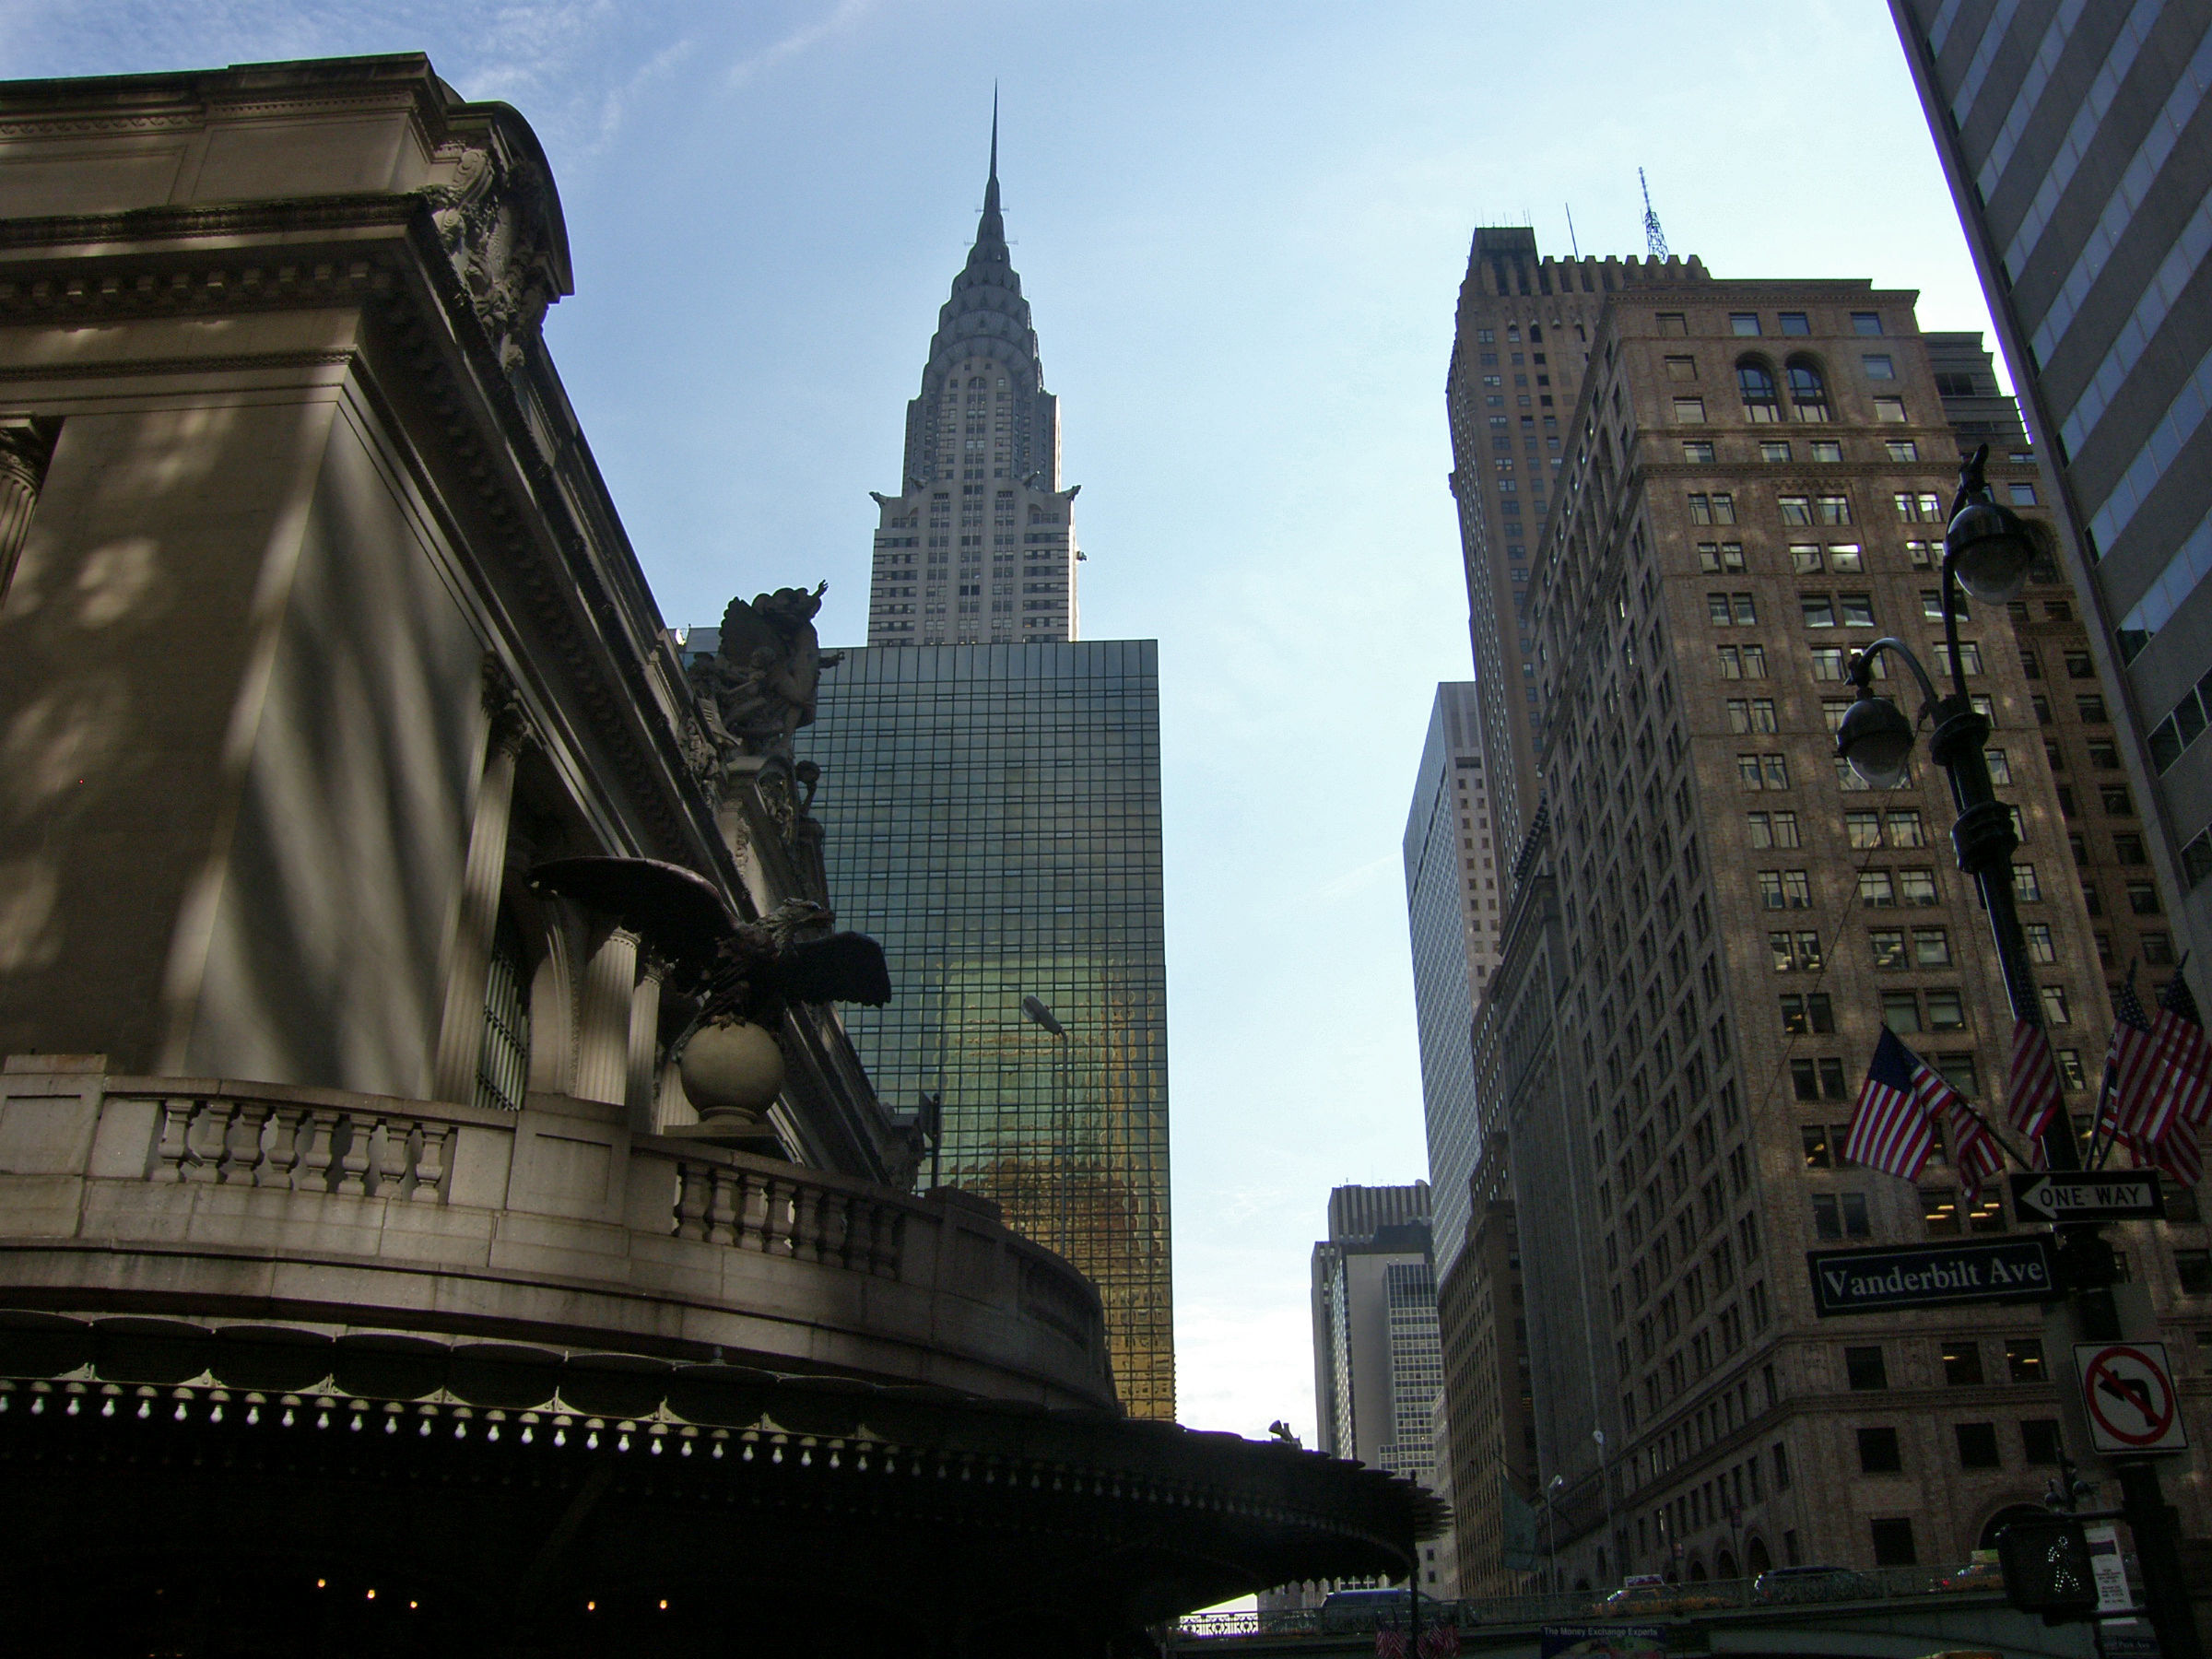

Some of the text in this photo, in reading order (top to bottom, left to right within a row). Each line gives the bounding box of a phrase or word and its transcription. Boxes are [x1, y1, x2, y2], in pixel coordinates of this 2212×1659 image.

[2040, 1186, 2138, 1206] ONE WAY
[1824, 1257, 2043, 1298] Vanderbilt Ave
[1544, 1627, 1658, 1638] The Money Exchange Experts
